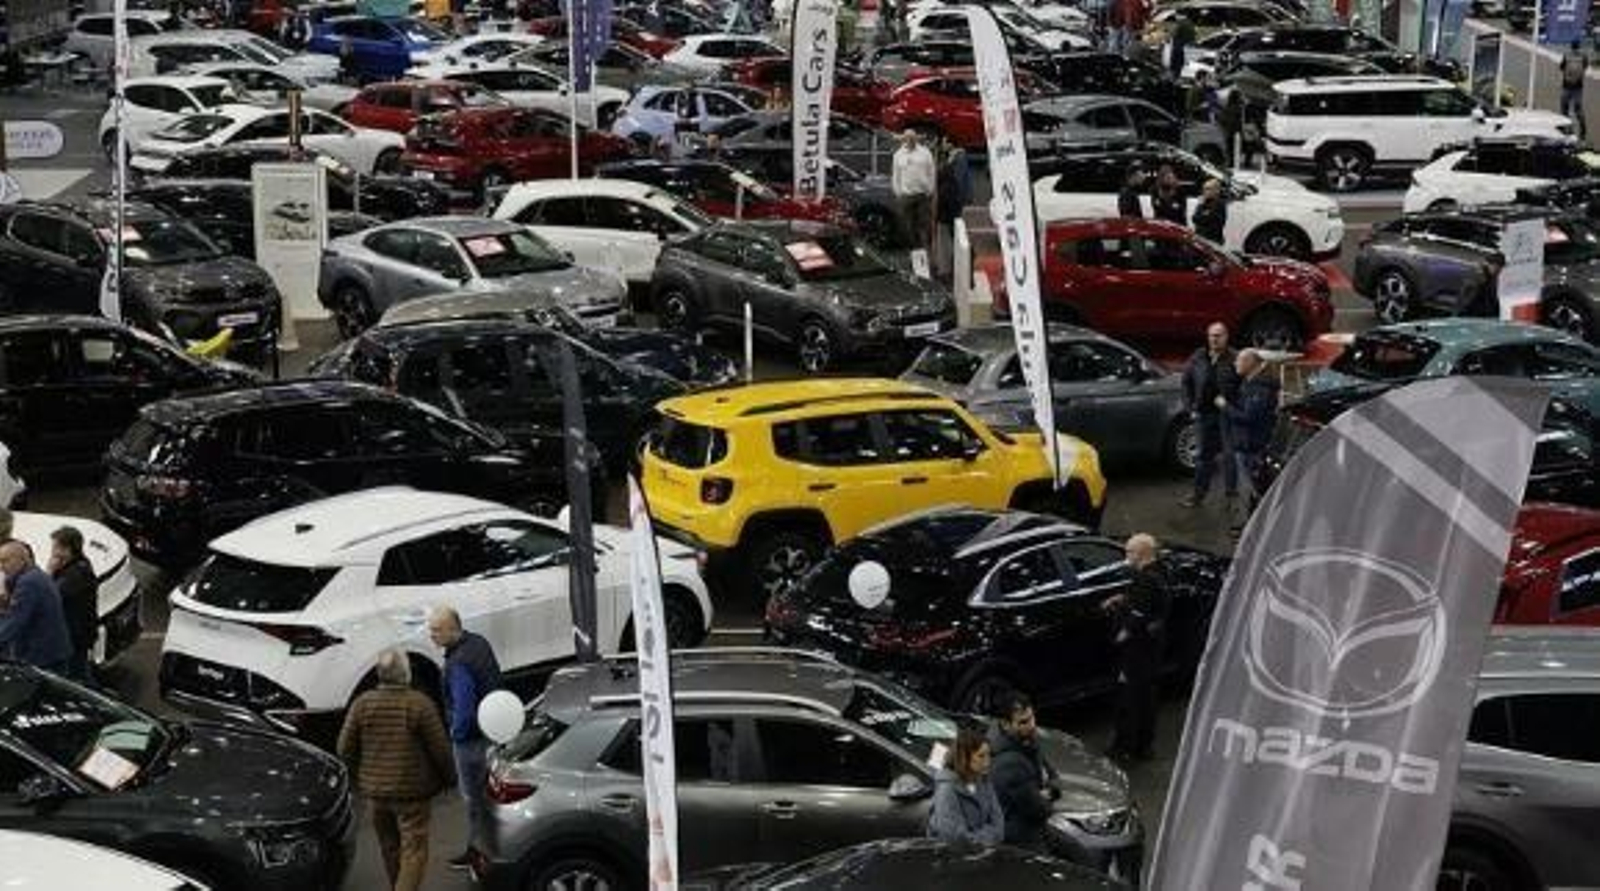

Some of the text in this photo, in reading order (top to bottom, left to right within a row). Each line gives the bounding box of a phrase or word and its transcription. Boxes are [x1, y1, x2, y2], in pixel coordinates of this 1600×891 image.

[802, 27, 829, 94] Cars
[801, 103, 820, 195] Betula
[1207, 717, 1440, 795] mazda
